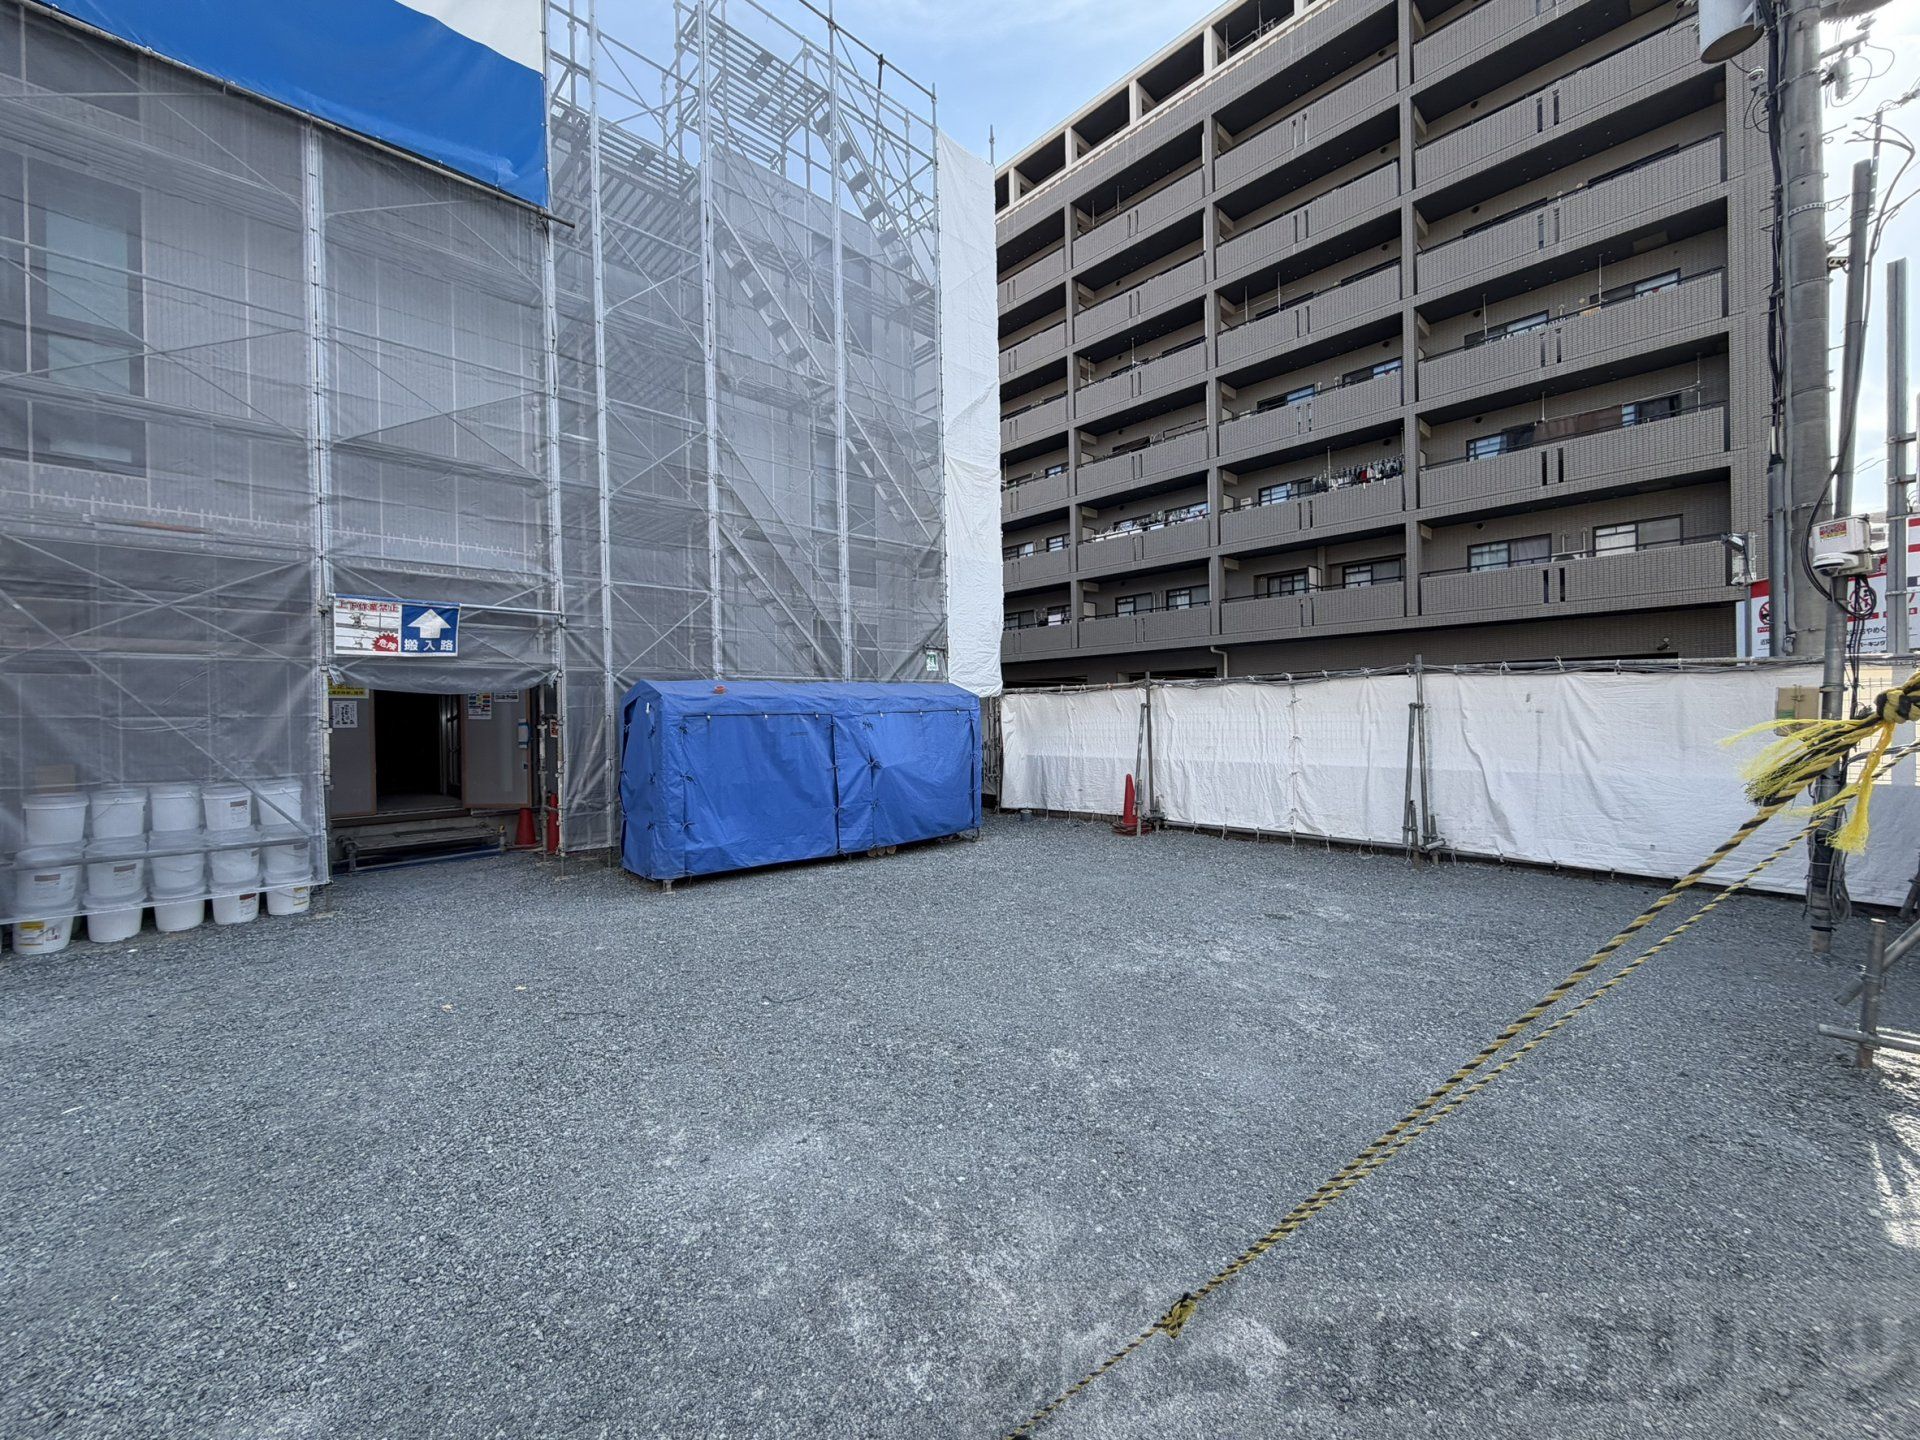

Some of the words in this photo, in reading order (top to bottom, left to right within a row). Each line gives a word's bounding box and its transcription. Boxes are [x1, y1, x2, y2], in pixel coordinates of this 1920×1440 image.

[377, 638, 397, 651] 危険
[404, 638, 454, 651] 搬入路
